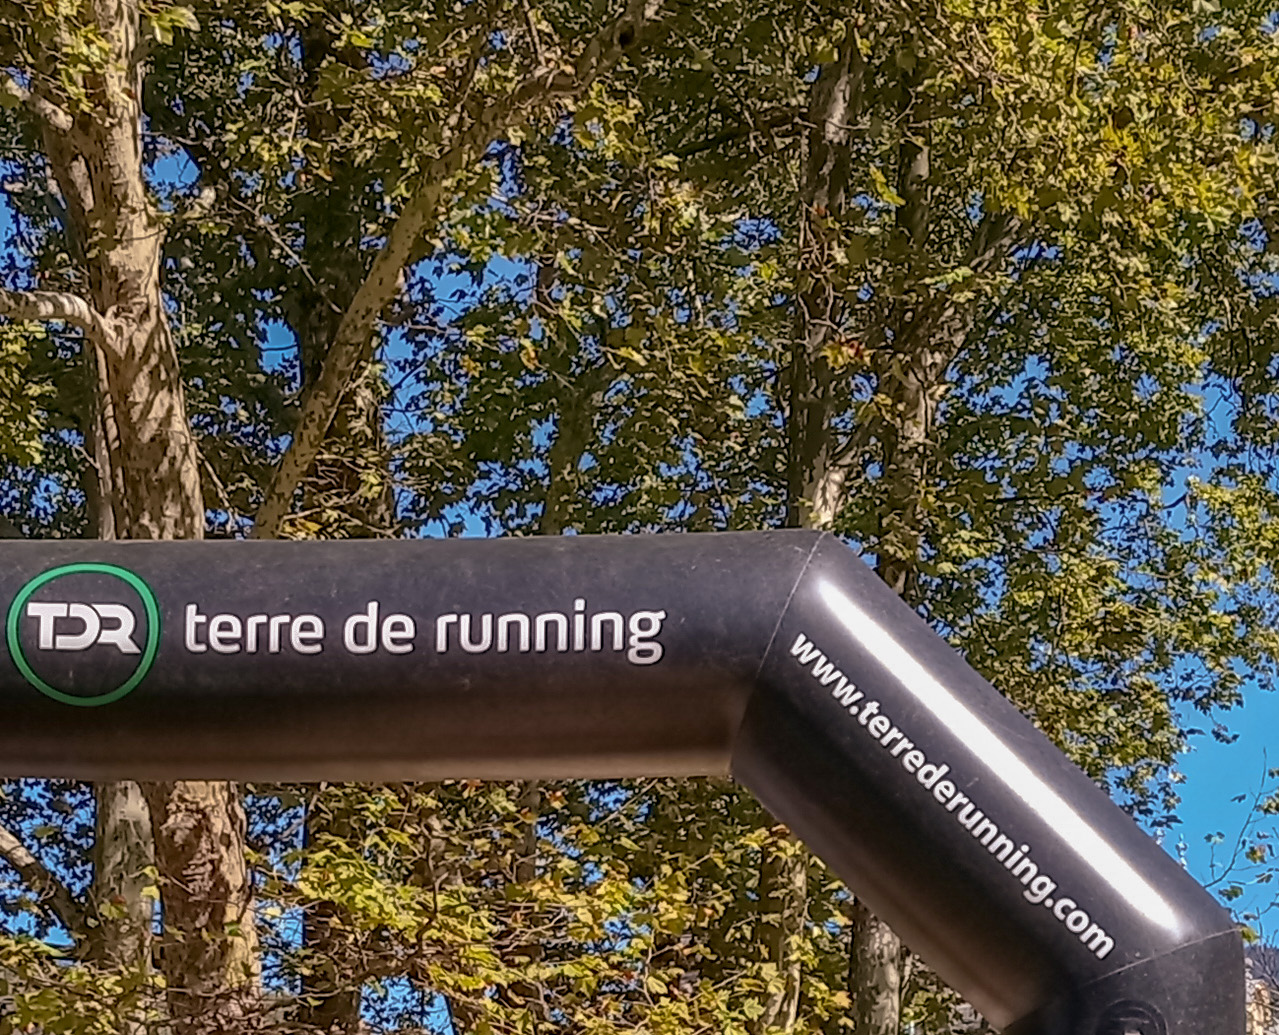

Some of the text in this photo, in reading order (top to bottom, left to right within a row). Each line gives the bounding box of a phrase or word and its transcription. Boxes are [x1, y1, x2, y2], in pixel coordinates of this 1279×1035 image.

[27, 598, 666, 665] TDR terre de running
[789, 632, 1116, 961] www.terrederunning.com
